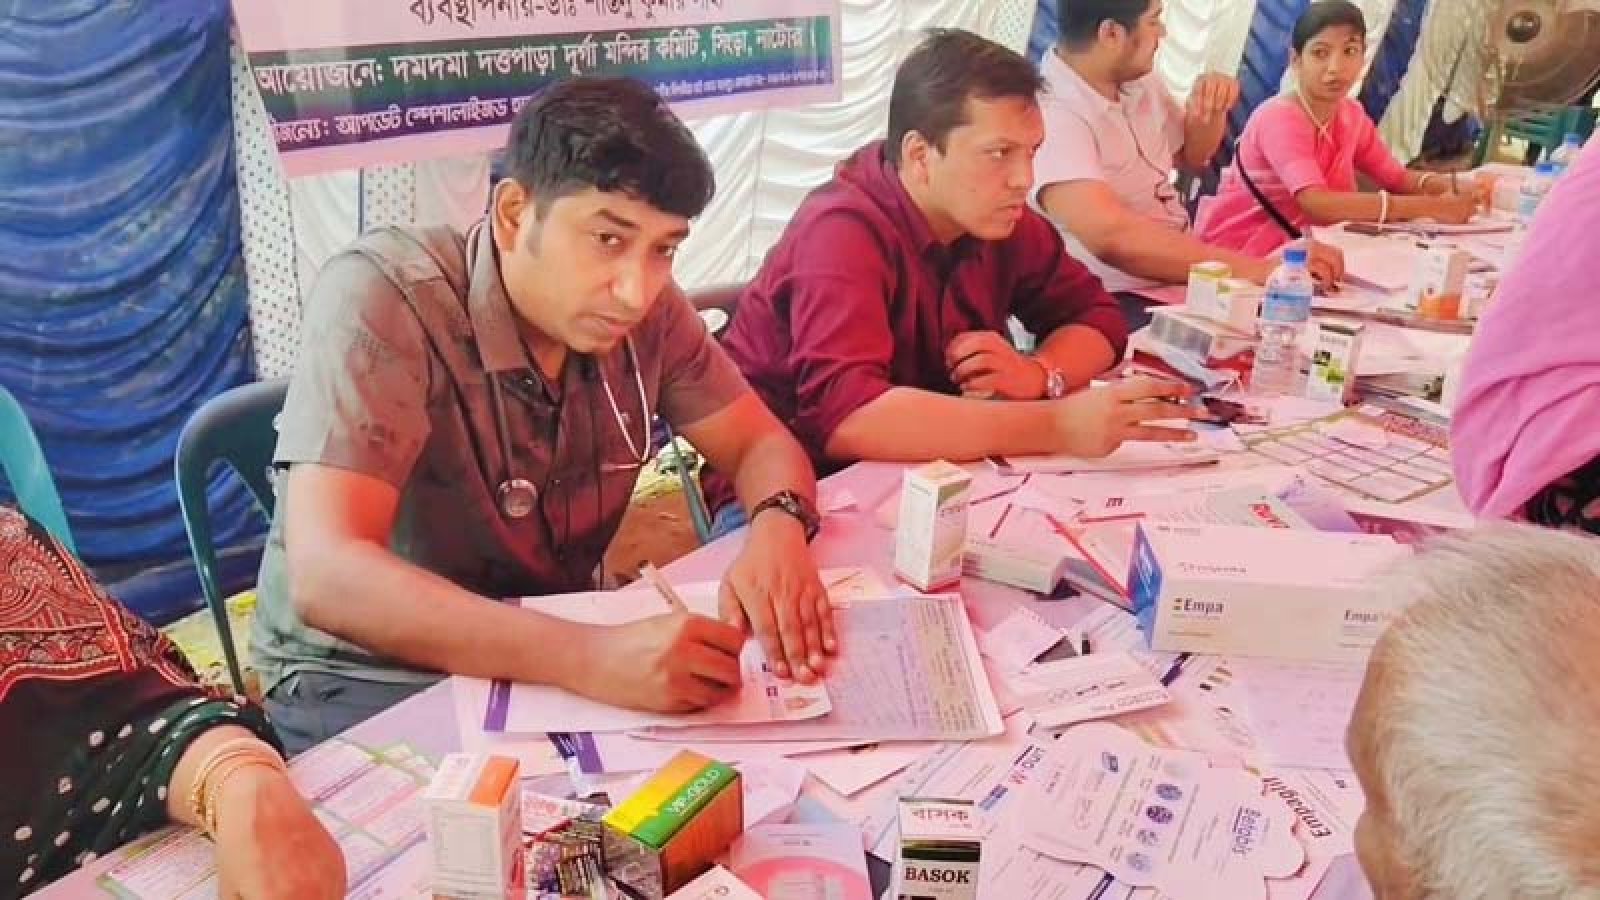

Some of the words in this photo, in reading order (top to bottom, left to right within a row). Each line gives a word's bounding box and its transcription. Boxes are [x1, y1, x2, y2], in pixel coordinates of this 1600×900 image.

[389, 51, 468, 82] দমদমা
[602, 32, 650, 64] মন্দির
[1183, 597, 1223, 615] Empa
[905, 866, 971, 884] BASOK
